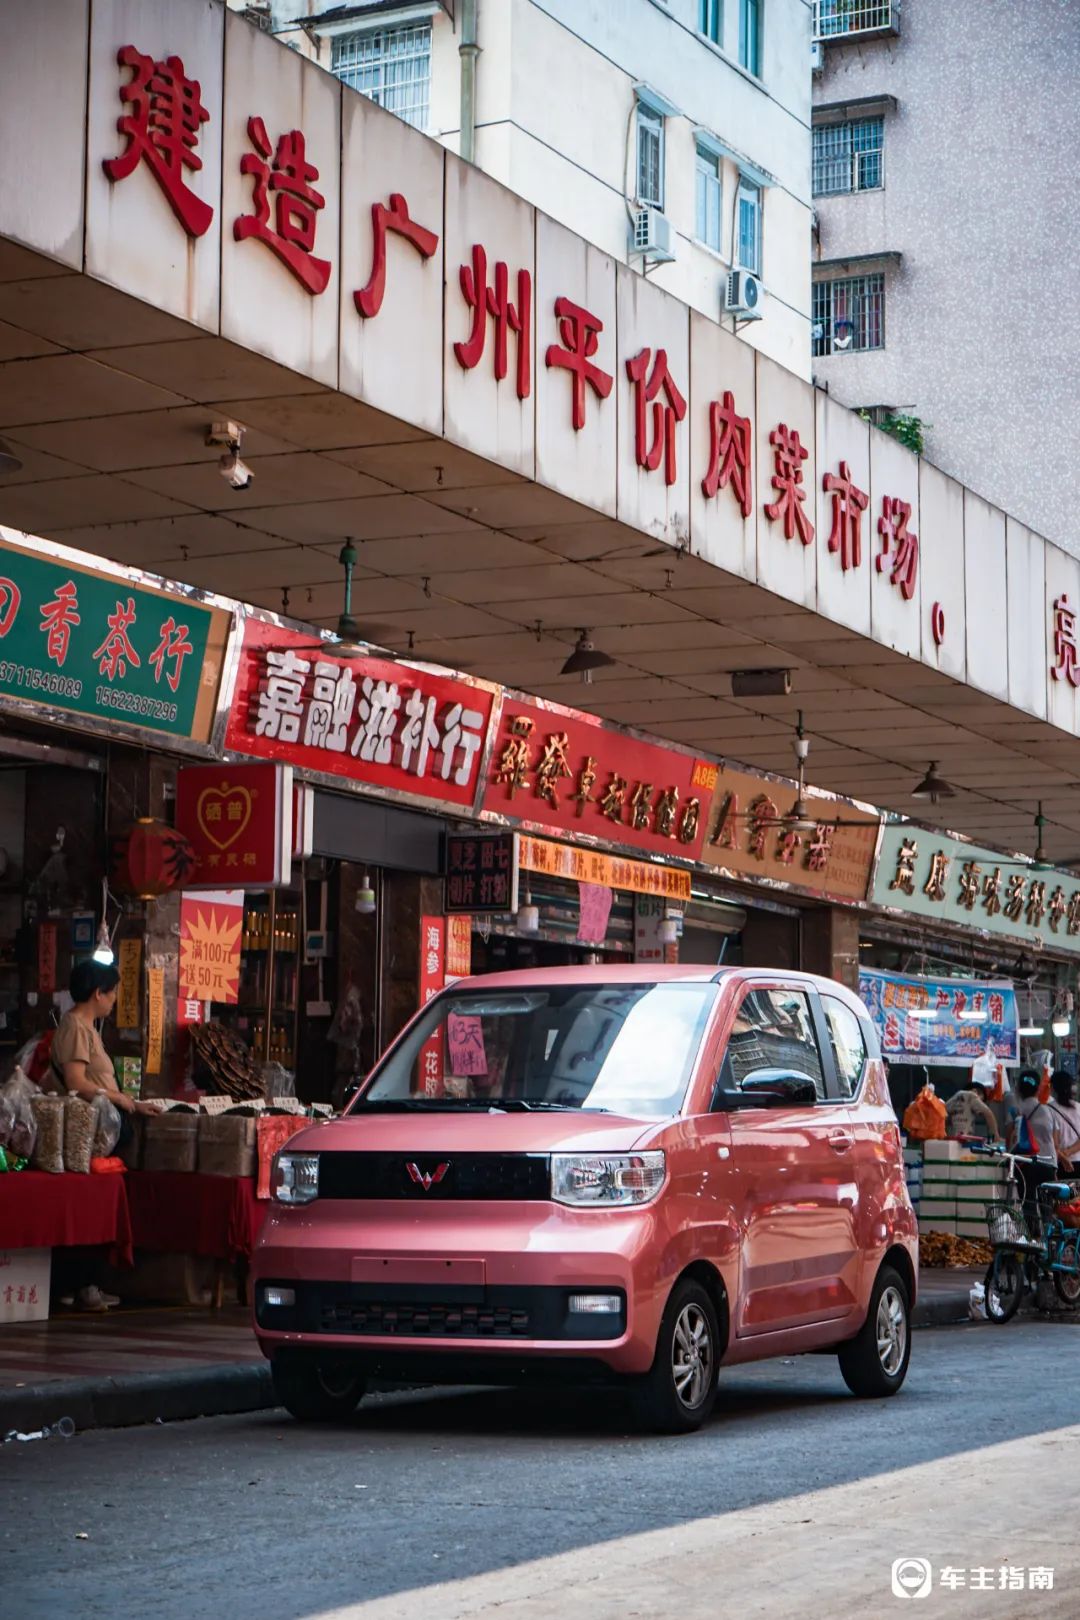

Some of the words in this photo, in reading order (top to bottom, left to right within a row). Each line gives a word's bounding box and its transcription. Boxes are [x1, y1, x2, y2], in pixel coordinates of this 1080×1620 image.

[95, 686, 178, 722] 15622387296
[256, 650, 483, 786] 嘉融滋补行
[192, 939, 232, 965] 满100元
[426, 926, 440, 975] 海参
[186, 964, 224, 988] 送50元
